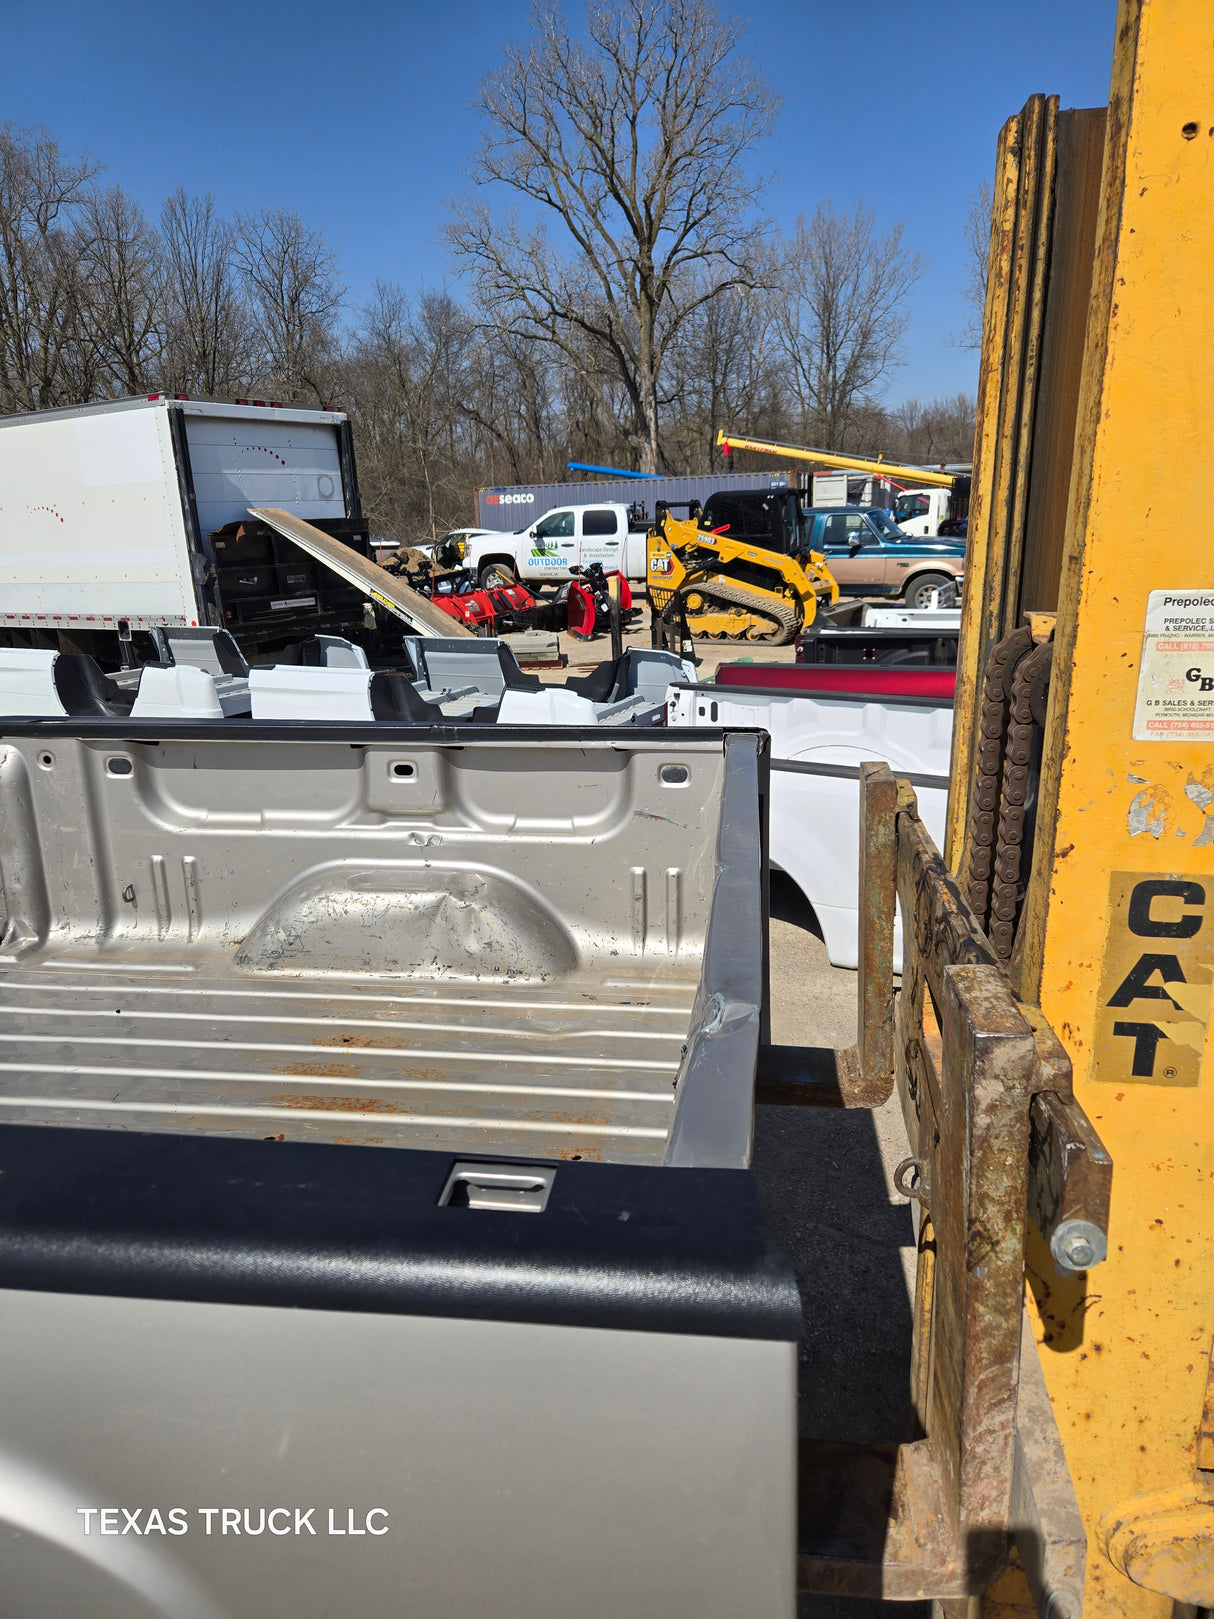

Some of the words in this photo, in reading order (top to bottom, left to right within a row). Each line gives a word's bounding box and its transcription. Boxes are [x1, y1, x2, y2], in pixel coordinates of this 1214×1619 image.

[486, 493, 535, 505] GEseaco
[528, 558, 568, 566] OUTDOOR
[650, 558, 669, 572] CAT
[1163, 597, 1214, 608] Prepolec
[1106, 880, 1206, 1077] CAT
